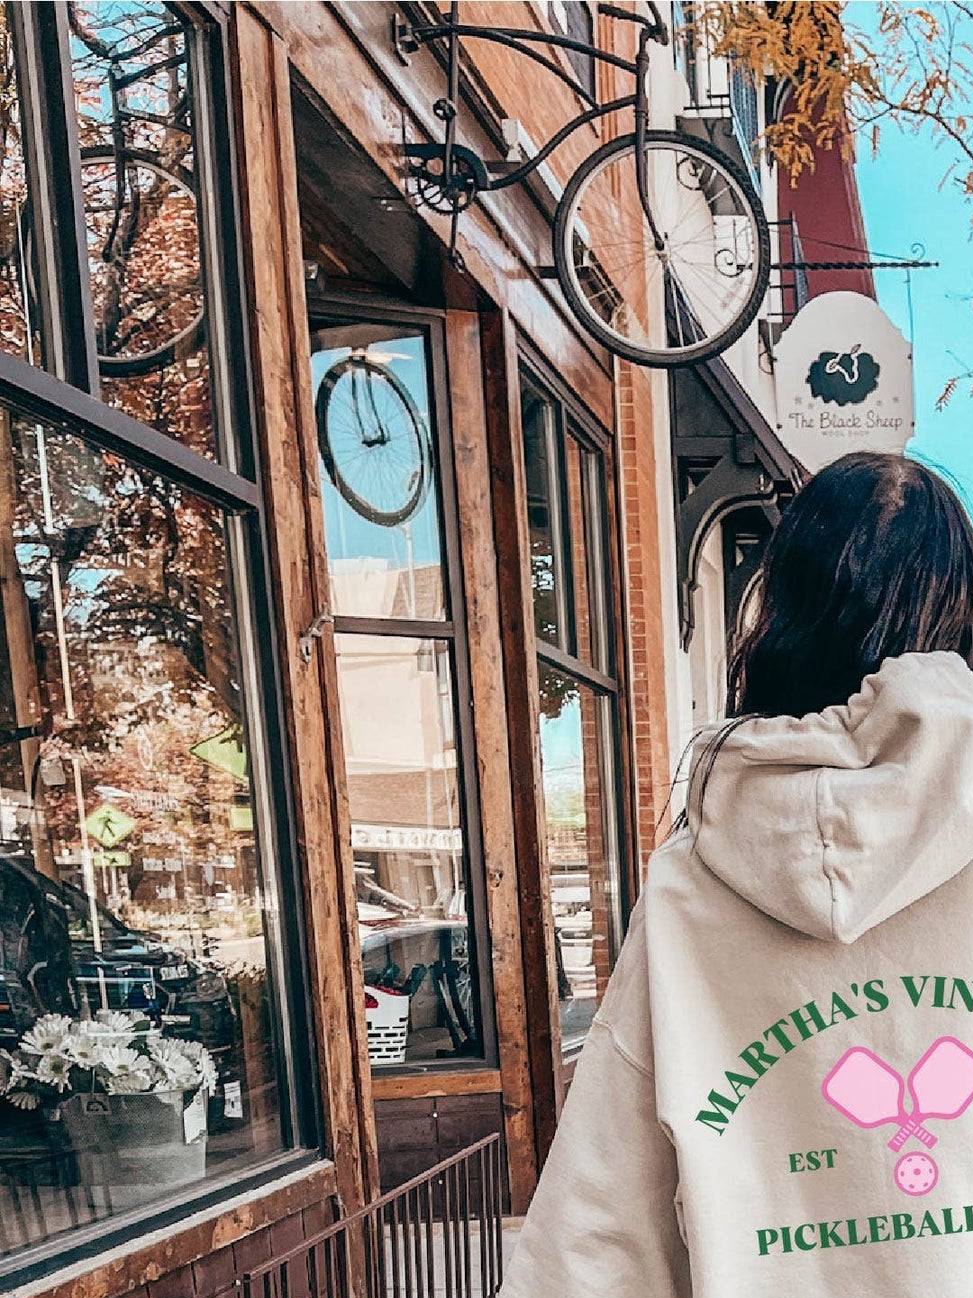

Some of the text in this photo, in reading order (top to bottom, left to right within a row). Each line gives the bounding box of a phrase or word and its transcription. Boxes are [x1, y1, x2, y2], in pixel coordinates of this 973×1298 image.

[788, 410, 903, 430] The Black Sheep
[695, 978, 890, 1136] MARTHA'S
[788, 1148, 838, 1173] EST
